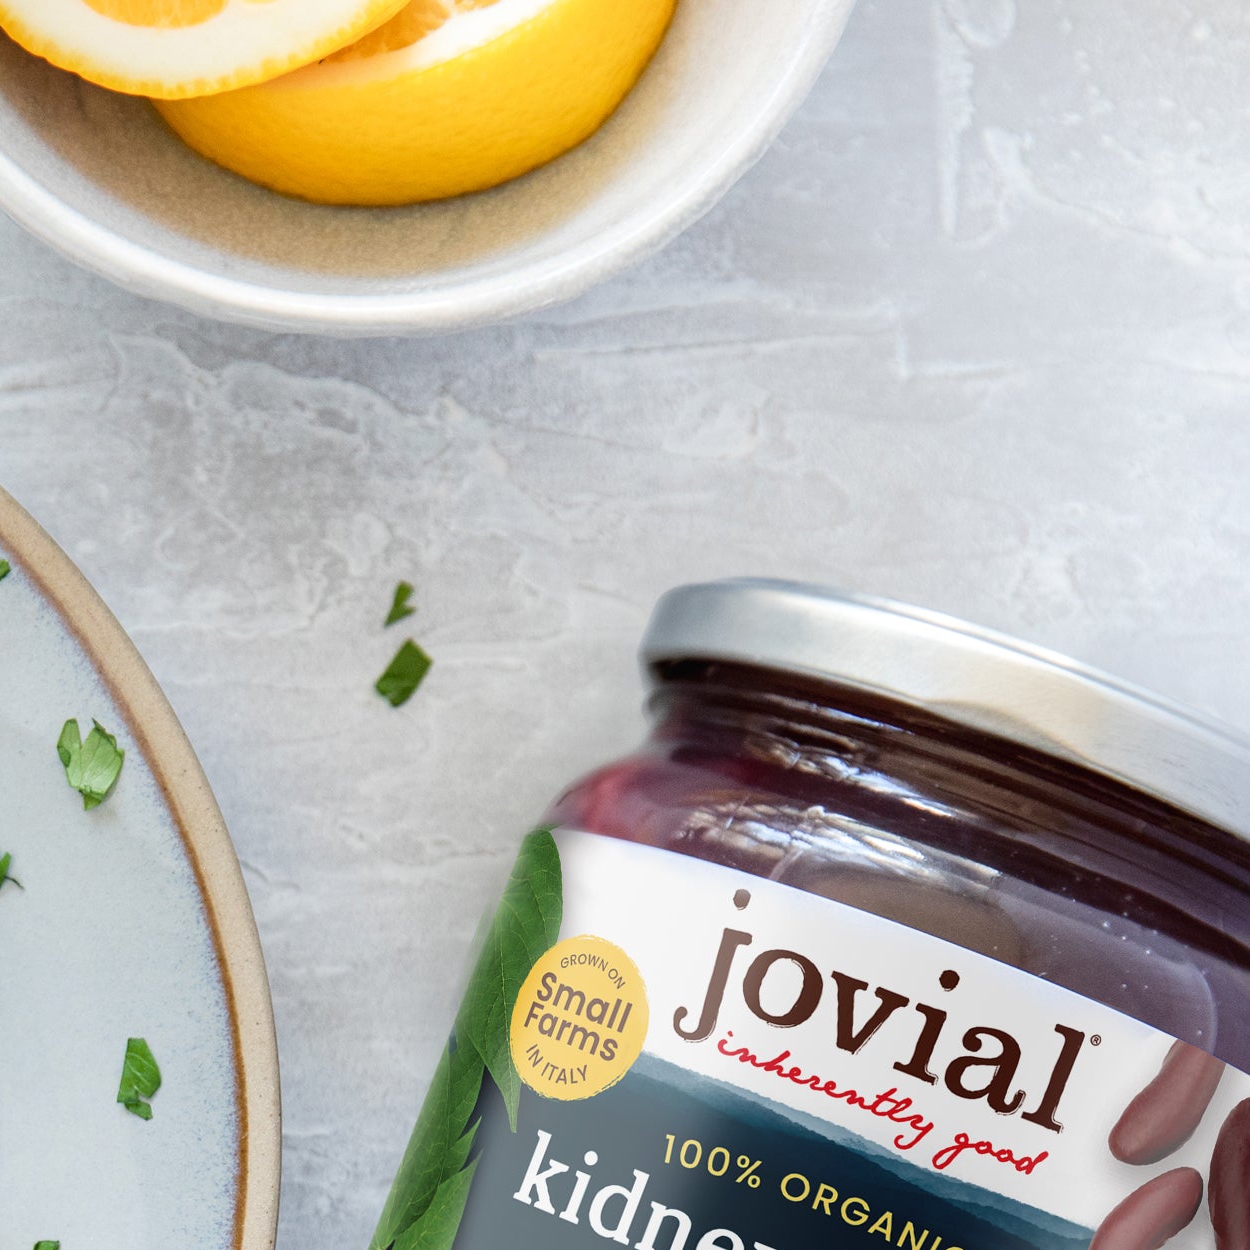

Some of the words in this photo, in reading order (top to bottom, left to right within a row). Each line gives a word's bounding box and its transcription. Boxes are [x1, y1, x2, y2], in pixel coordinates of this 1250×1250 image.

[560, 954, 609, 972] GROWN
[608, 968, 626, 990] ON
[524, 1001, 619, 1061] Farms
[536, 972, 633, 1033] Small
[526, 1043, 544, 1068] IN
[541, 1062, 588, 1085] ITALY
[717, 1030, 933, 1150] inherently
[932, 1132, 1049, 1175] good
[664, 1134, 762, 1189] 100%
